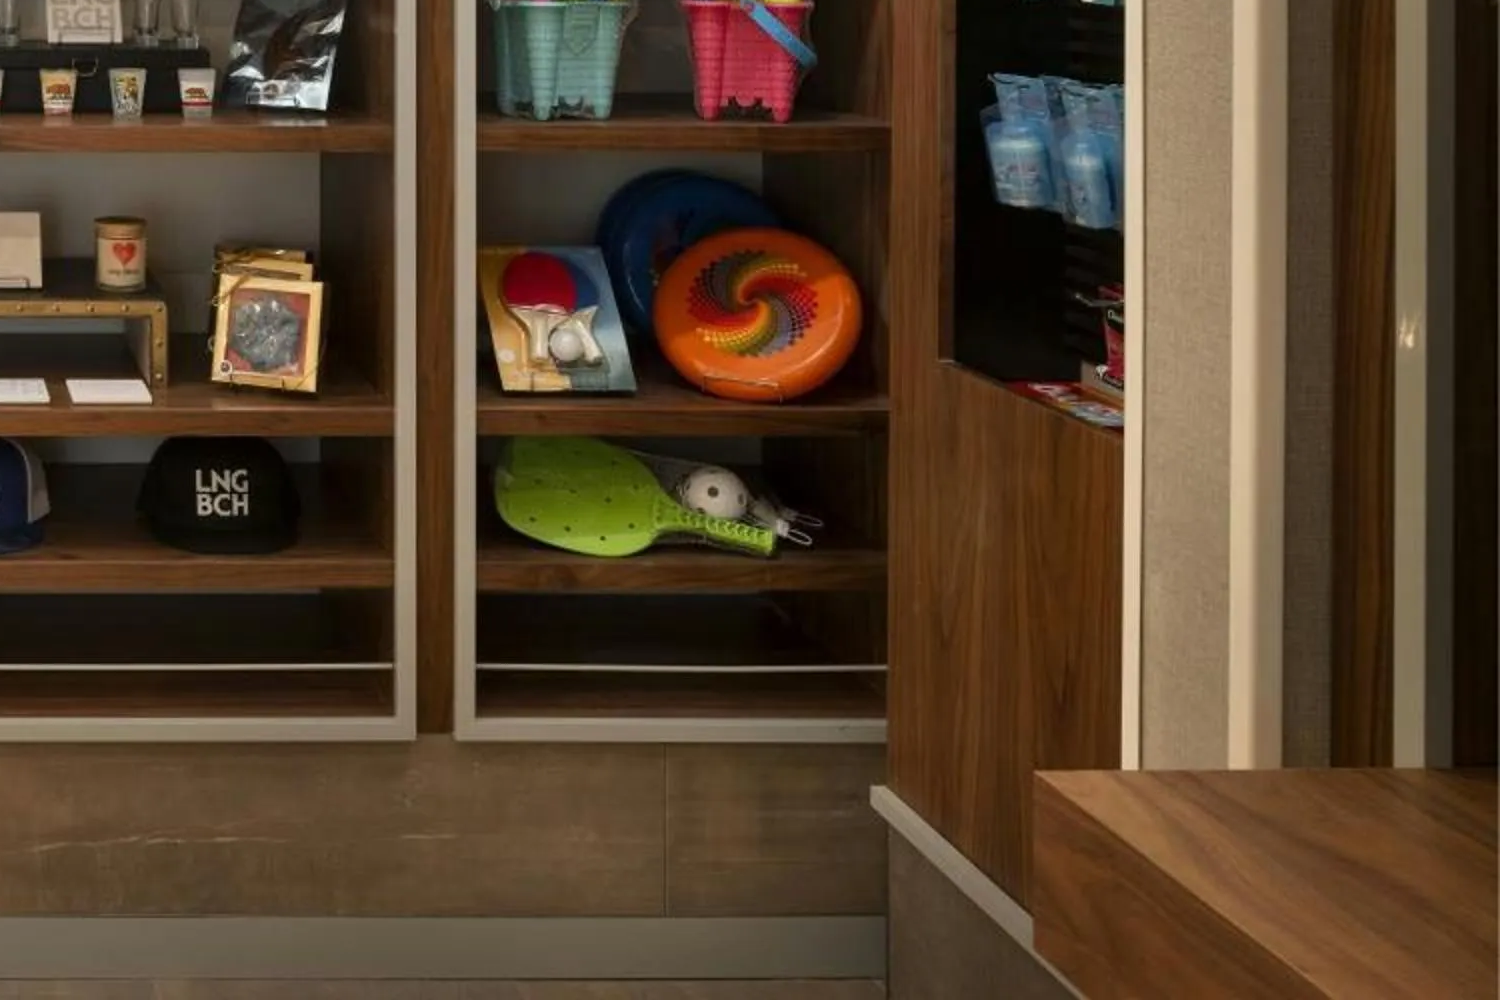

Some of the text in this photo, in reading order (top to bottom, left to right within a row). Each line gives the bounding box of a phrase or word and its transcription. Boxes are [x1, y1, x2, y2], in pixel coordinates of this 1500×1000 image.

[52, 6, 115, 30] BCH
[195, 469, 249, 493] LNG
[196, 493, 249, 517] BCH
